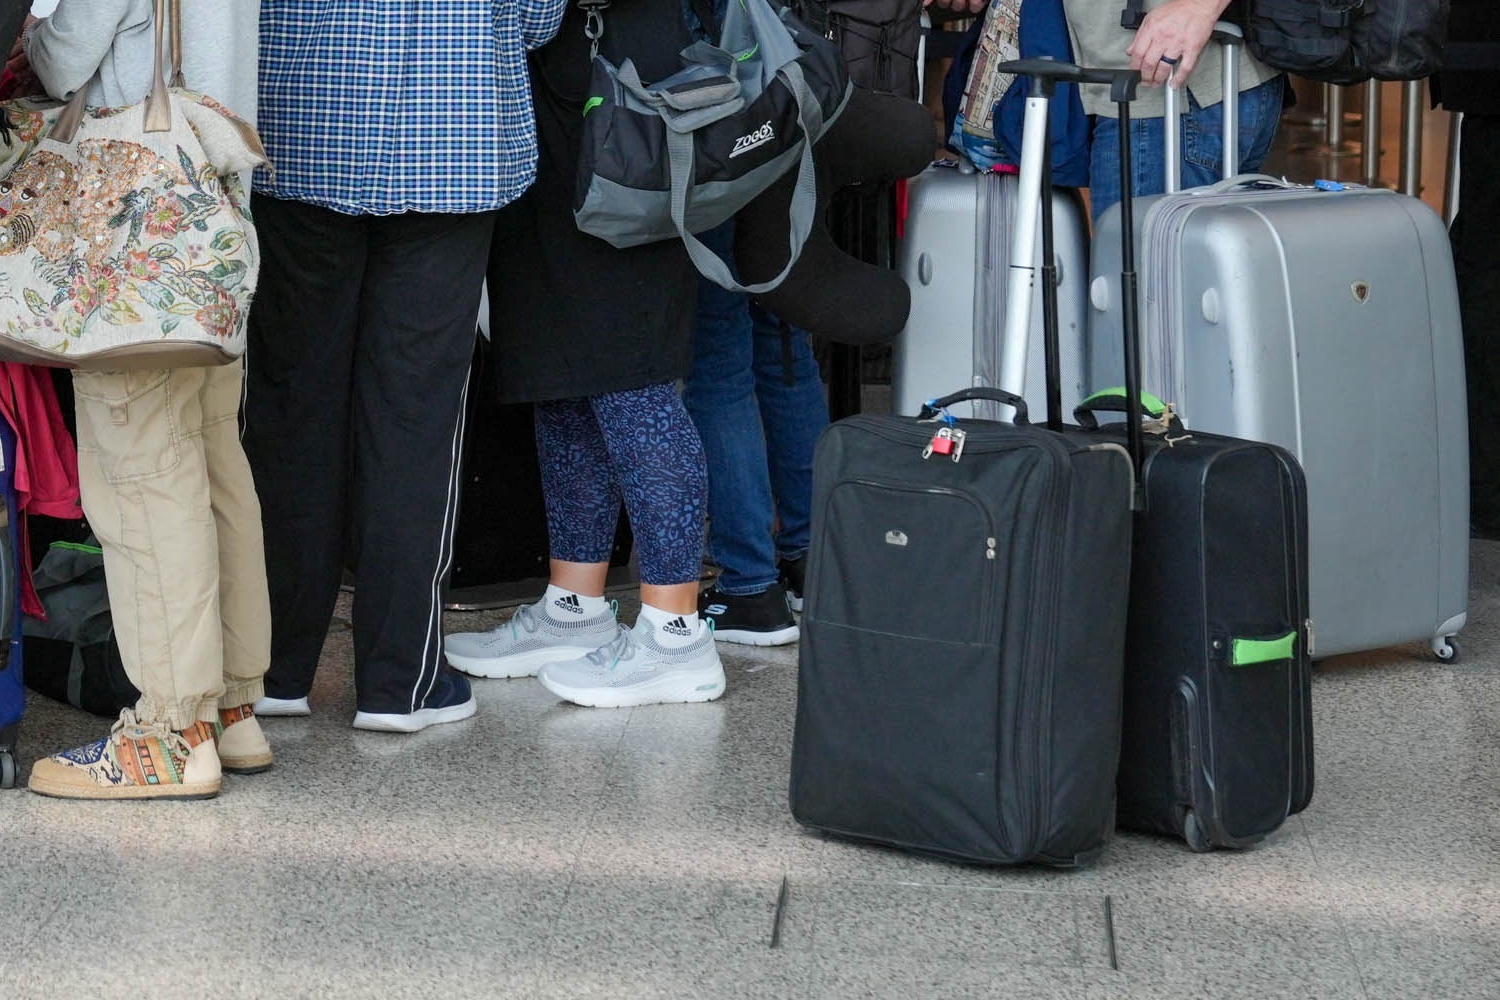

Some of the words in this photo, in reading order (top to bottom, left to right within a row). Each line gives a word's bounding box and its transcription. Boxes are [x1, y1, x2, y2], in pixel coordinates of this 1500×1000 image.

[732, 120, 774, 152] ZOGGS
[554, 599, 584, 615] adidas
[662, 624, 692, 636] adidas
